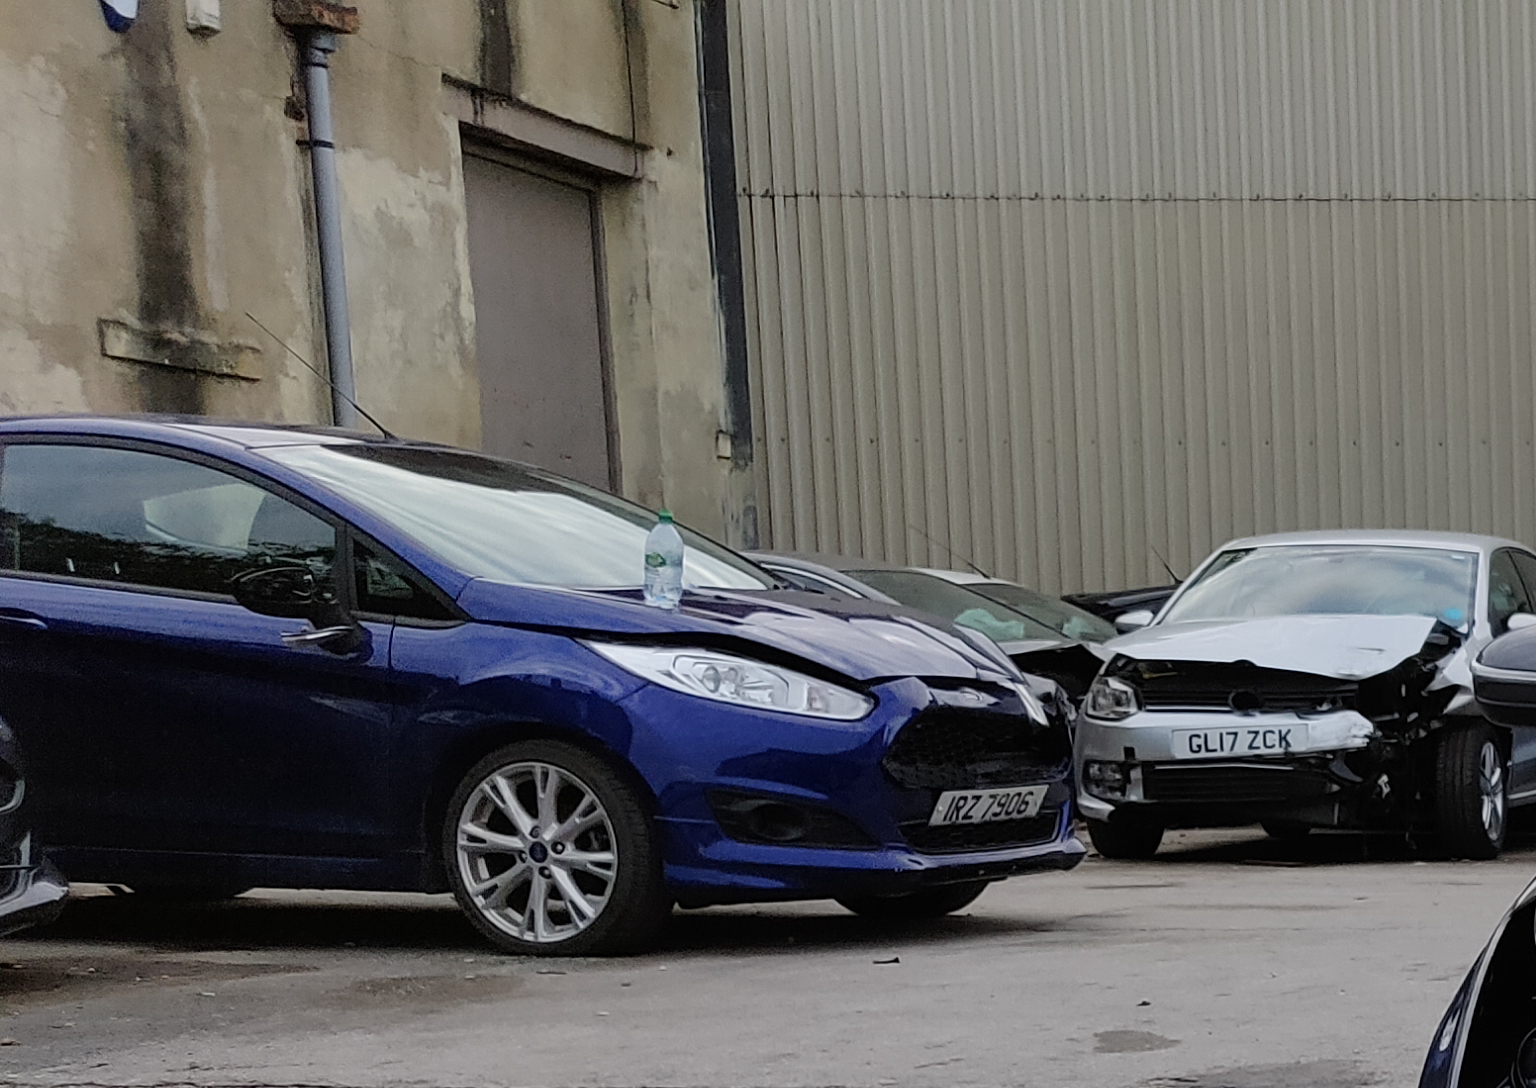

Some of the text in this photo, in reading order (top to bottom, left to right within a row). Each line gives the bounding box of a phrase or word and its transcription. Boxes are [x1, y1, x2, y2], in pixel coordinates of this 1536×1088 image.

[1188, 728, 1292, 754] GL17 ZCK
[942, 790, 1034, 822] IRZ 7906
